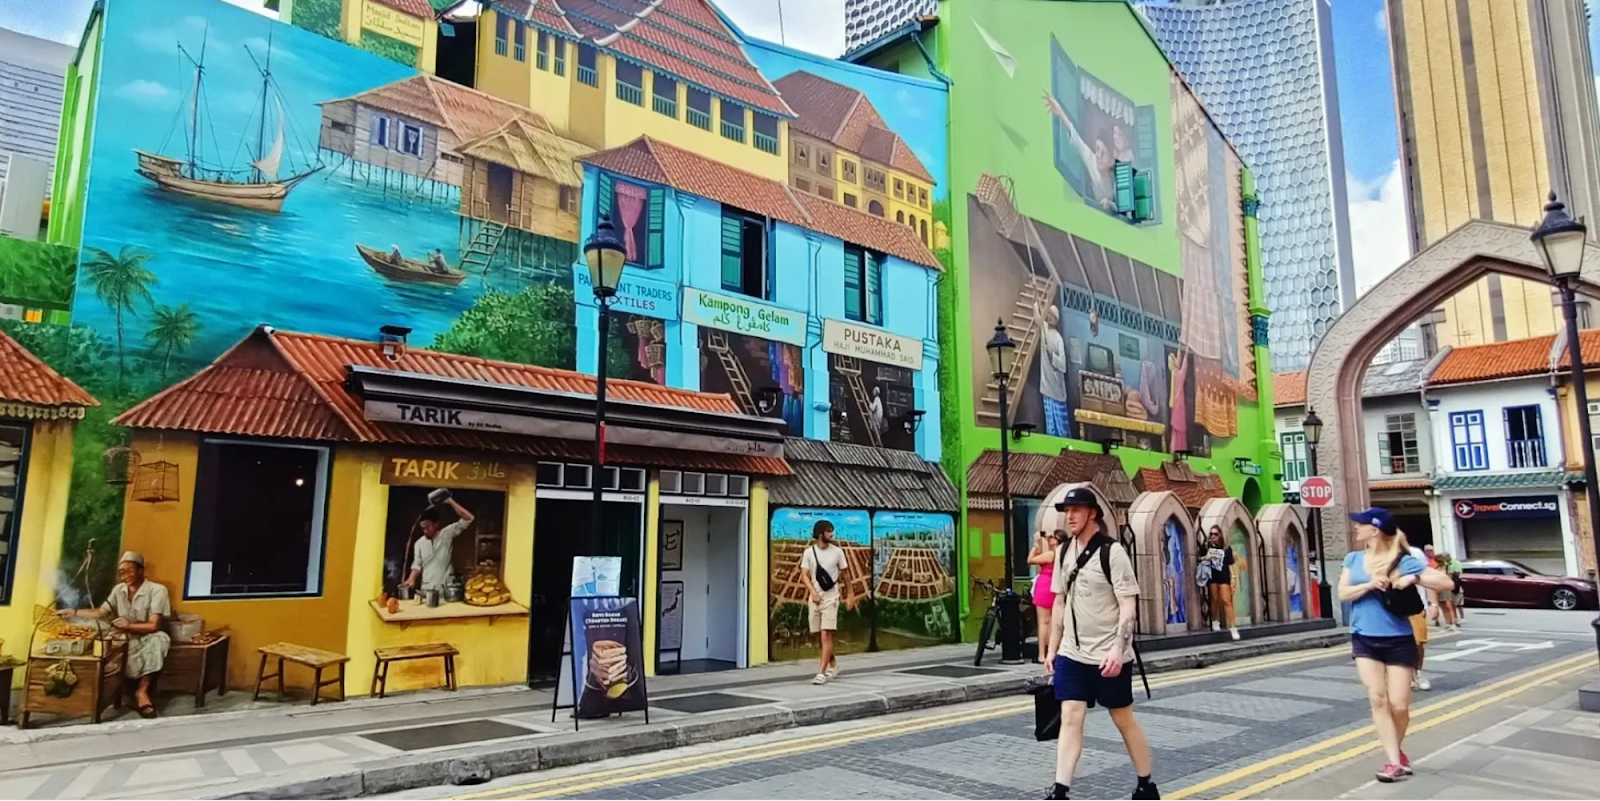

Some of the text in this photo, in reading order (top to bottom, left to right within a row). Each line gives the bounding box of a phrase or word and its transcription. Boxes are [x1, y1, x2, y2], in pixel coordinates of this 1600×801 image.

[395, 14, 421, 31] Sultan
[636, 285, 672, 301] TRADERS
[608, 296, 656, 311] EXTILES
[699, 293, 790, 326] Kampong Gelam
[844, 328, 902, 353] PUSTAKA
[833, 341, 915, 365] HAJI MUHAMMAD SAID
[397, 404, 462, 426] TARIK
[392, 458, 460, 480] TARIK
[466, 460, 505, 480] طارق
[1301, 485, 1332, 498] STOP
[1473, 501, 1556, 512] TravelConnect.sg
